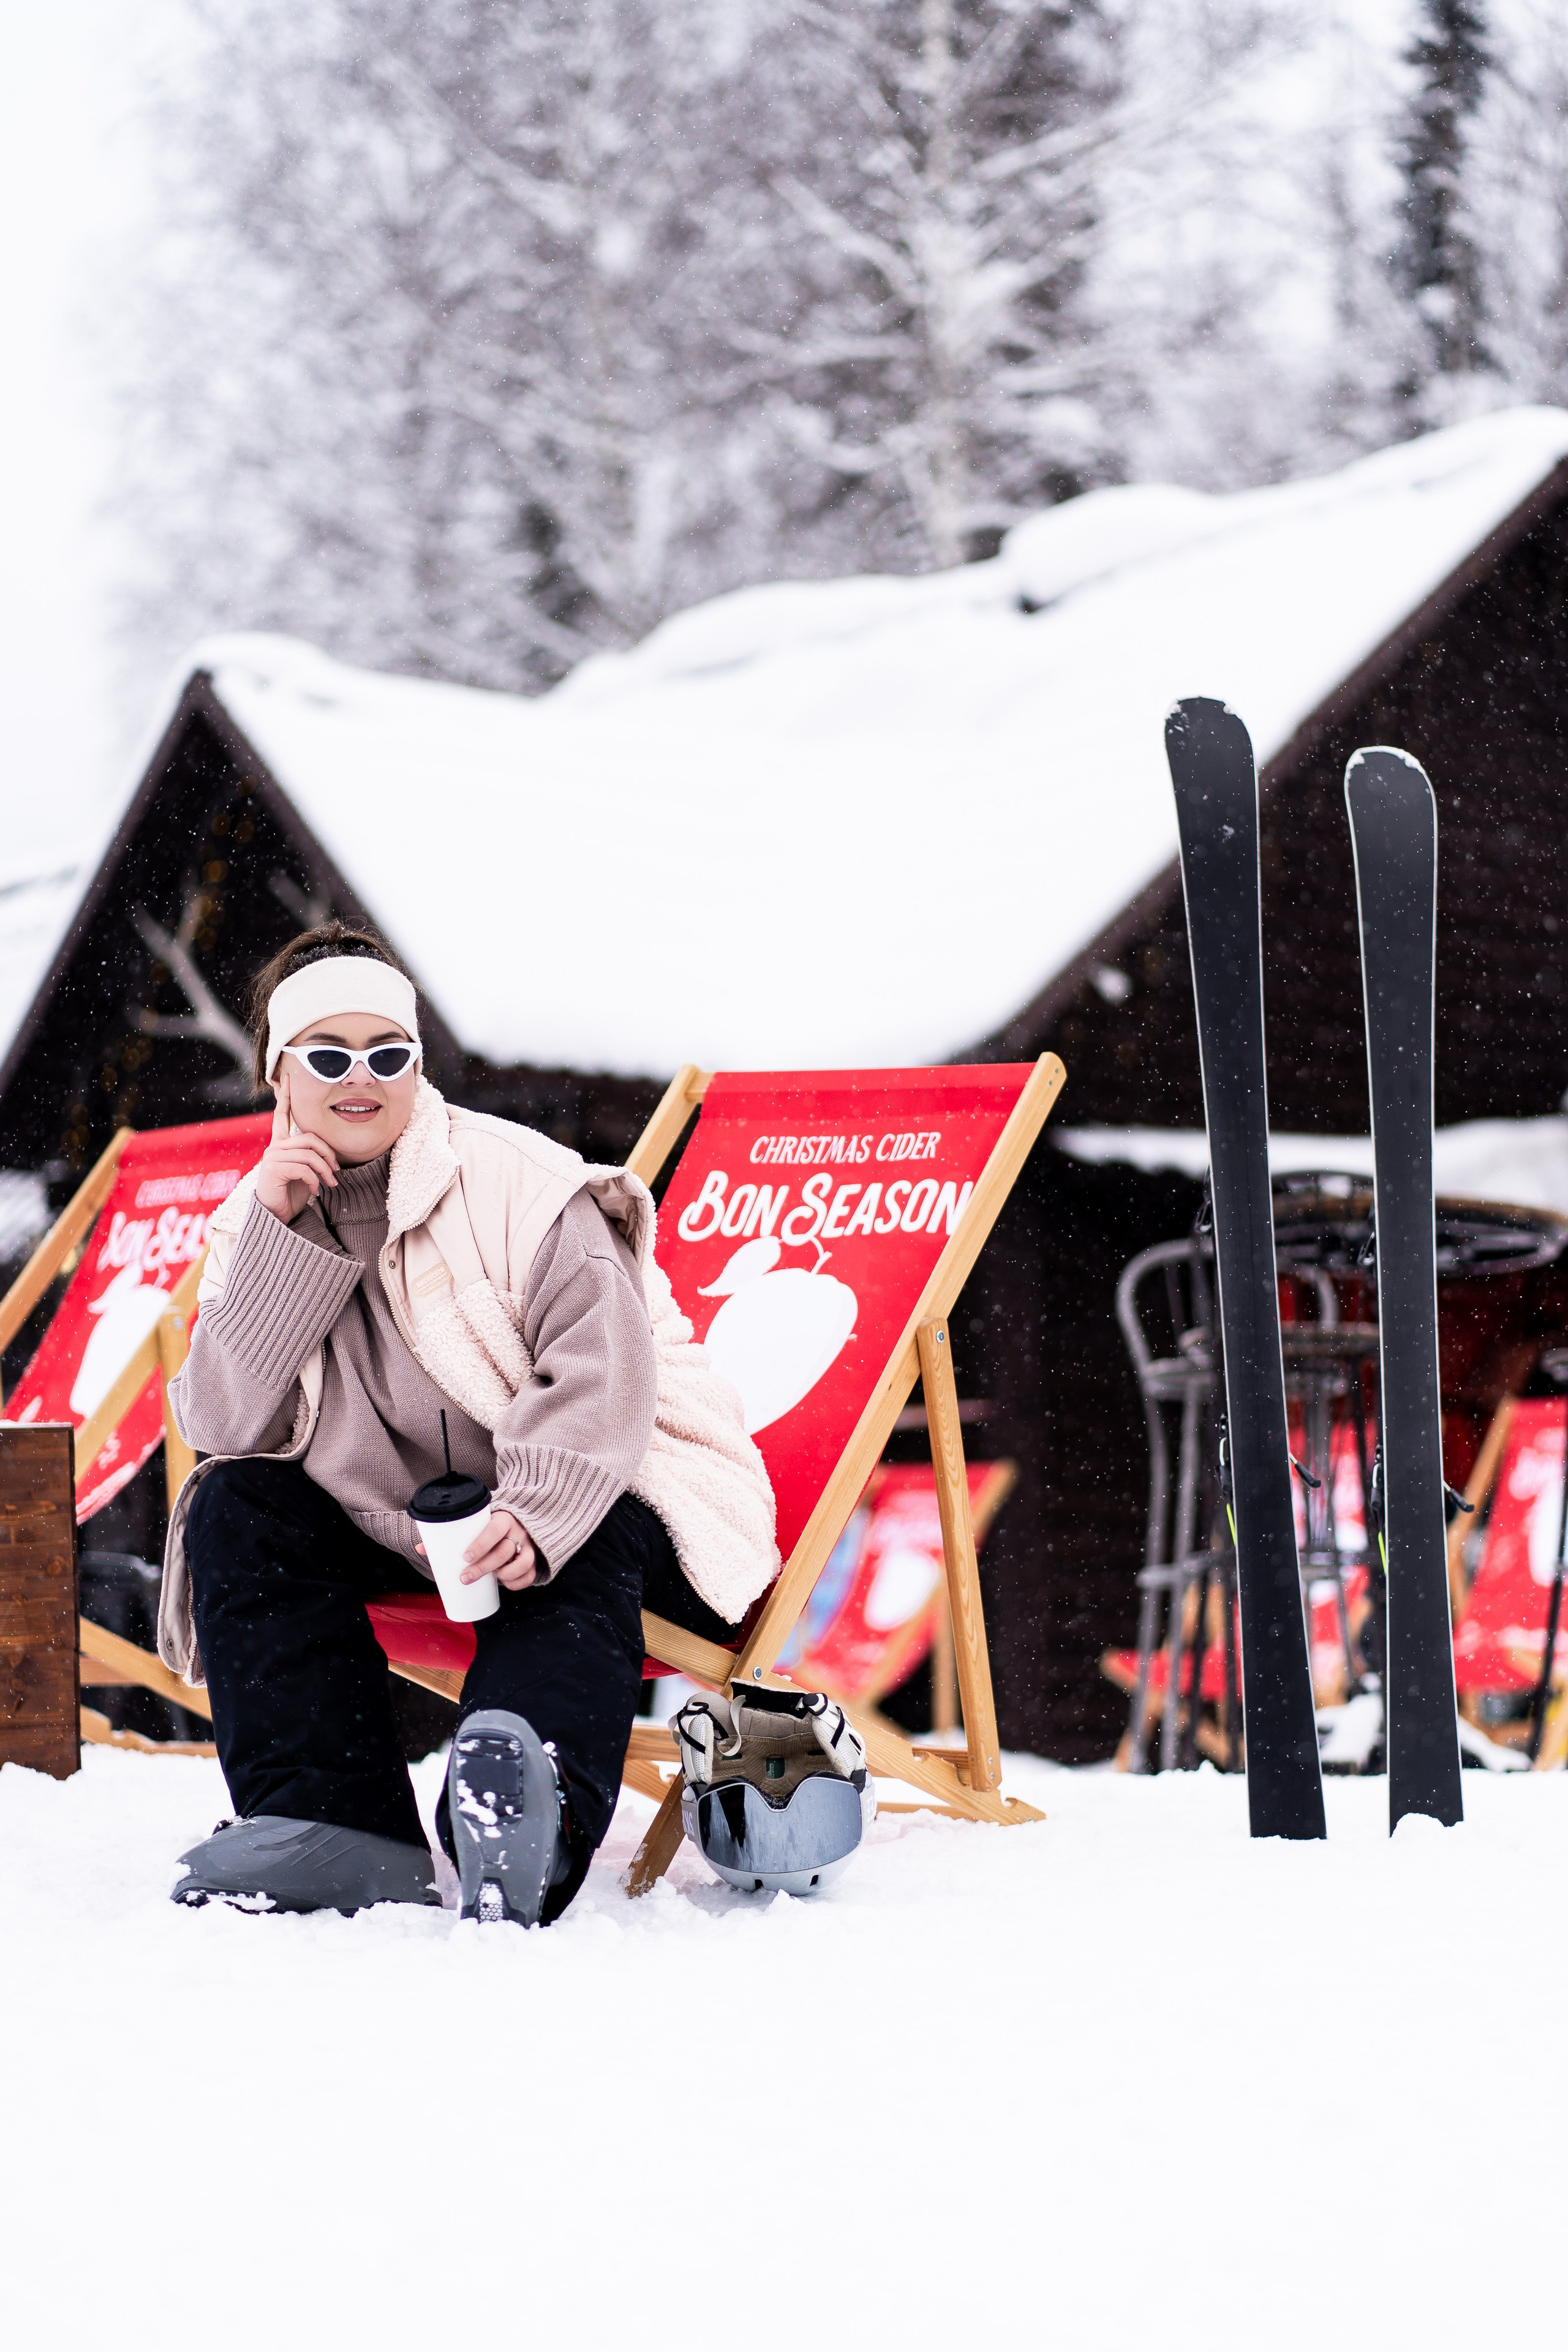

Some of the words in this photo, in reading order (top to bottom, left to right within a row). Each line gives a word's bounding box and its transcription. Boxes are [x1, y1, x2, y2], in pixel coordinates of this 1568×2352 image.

[750, 1135, 873, 1164] CHRISTMAS
[875, 1132, 941, 1162] CIDER
[678, 1170, 789, 1242] BON
[780, 1172, 974, 1246] SEASON
